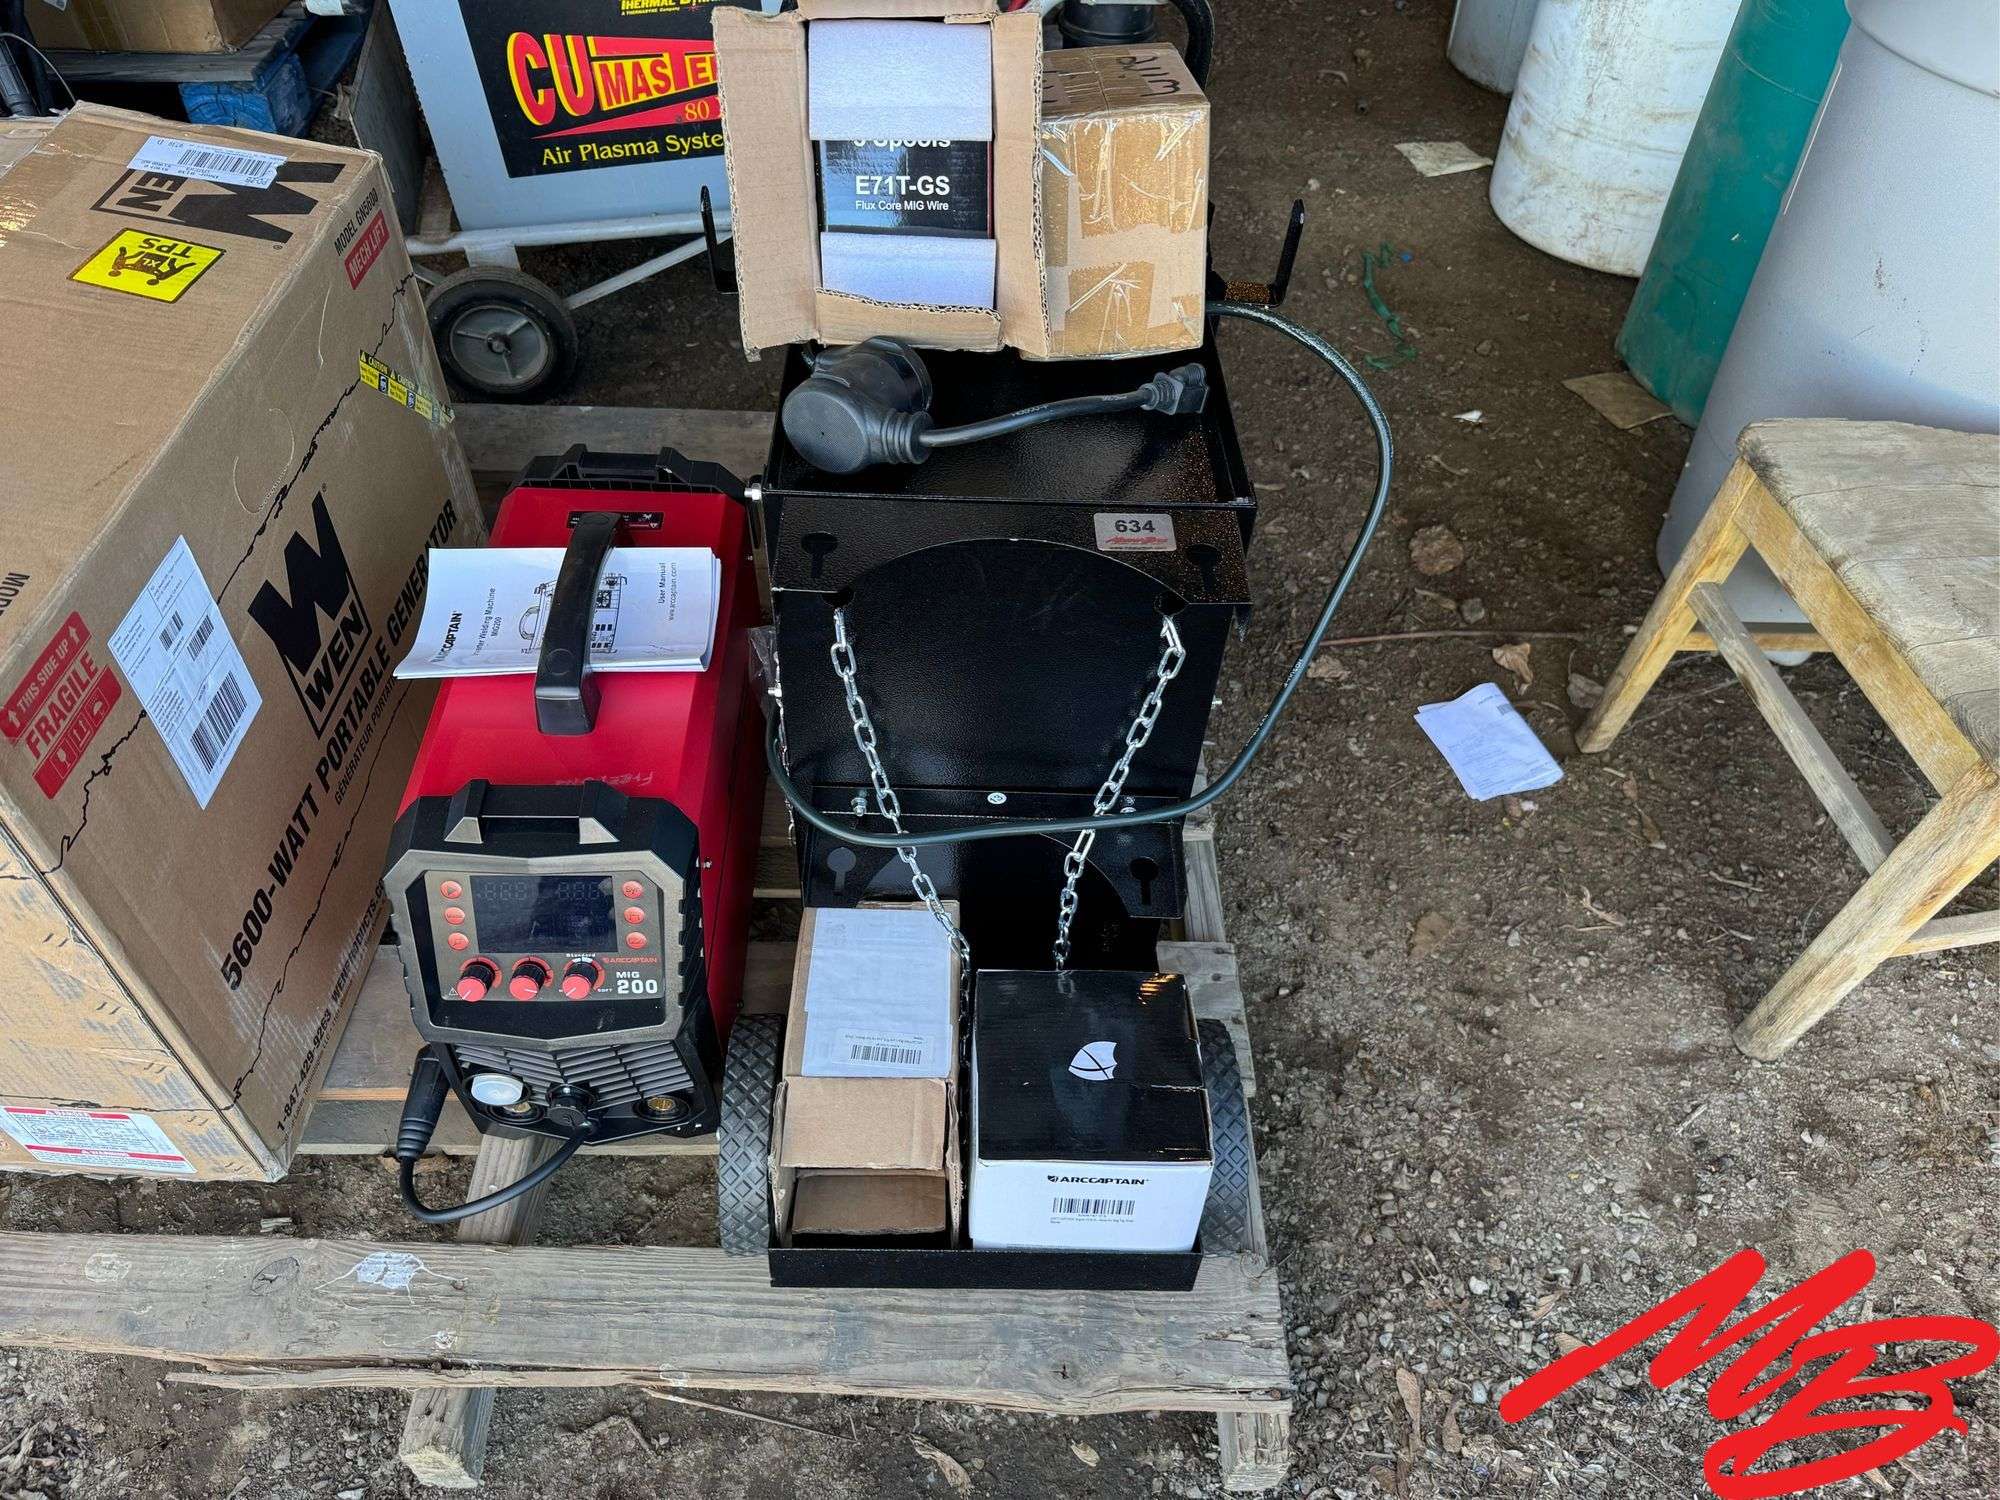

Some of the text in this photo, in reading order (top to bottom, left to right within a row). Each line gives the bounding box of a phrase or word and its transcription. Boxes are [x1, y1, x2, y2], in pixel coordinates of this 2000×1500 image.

[684, 101, 711, 121] 80
[542, 131, 724, 166] Air Plasma Syste
[117, 172, 188, 212] EN
[855, 175, 951, 196] E71T-GS
[334, 187, 379, 256] MODEL GN5600
[855, 200, 949, 211] Flux Core MIG Wire
[139, 237, 194, 258] TPS
[142, 258, 160, 268] XL
[348, 218, 386, 280] MECH LIFT
[1114, 519, 1156, 533] 634
[658, 562, 666, 604] User Manual
[485, 587, 496, 616] Machine
[304, 600, 365, 713] WEN
[18, 638, 69, 712] THIS SIDE UP
[26, 650, 99, 760] FRAGILE
[371, 676, 398, 727] PORTATI
[220, 498, 459, 991] 5600-WATT PORTABLE GENERTOR
[616, 971, 641, 979] MIG
[617, 979, 658, 995] 200
[276, 1008, 332, 1132] 1-847-429-9263
[1060, 1176, 1145, 1185] ARCCAPTAIN
